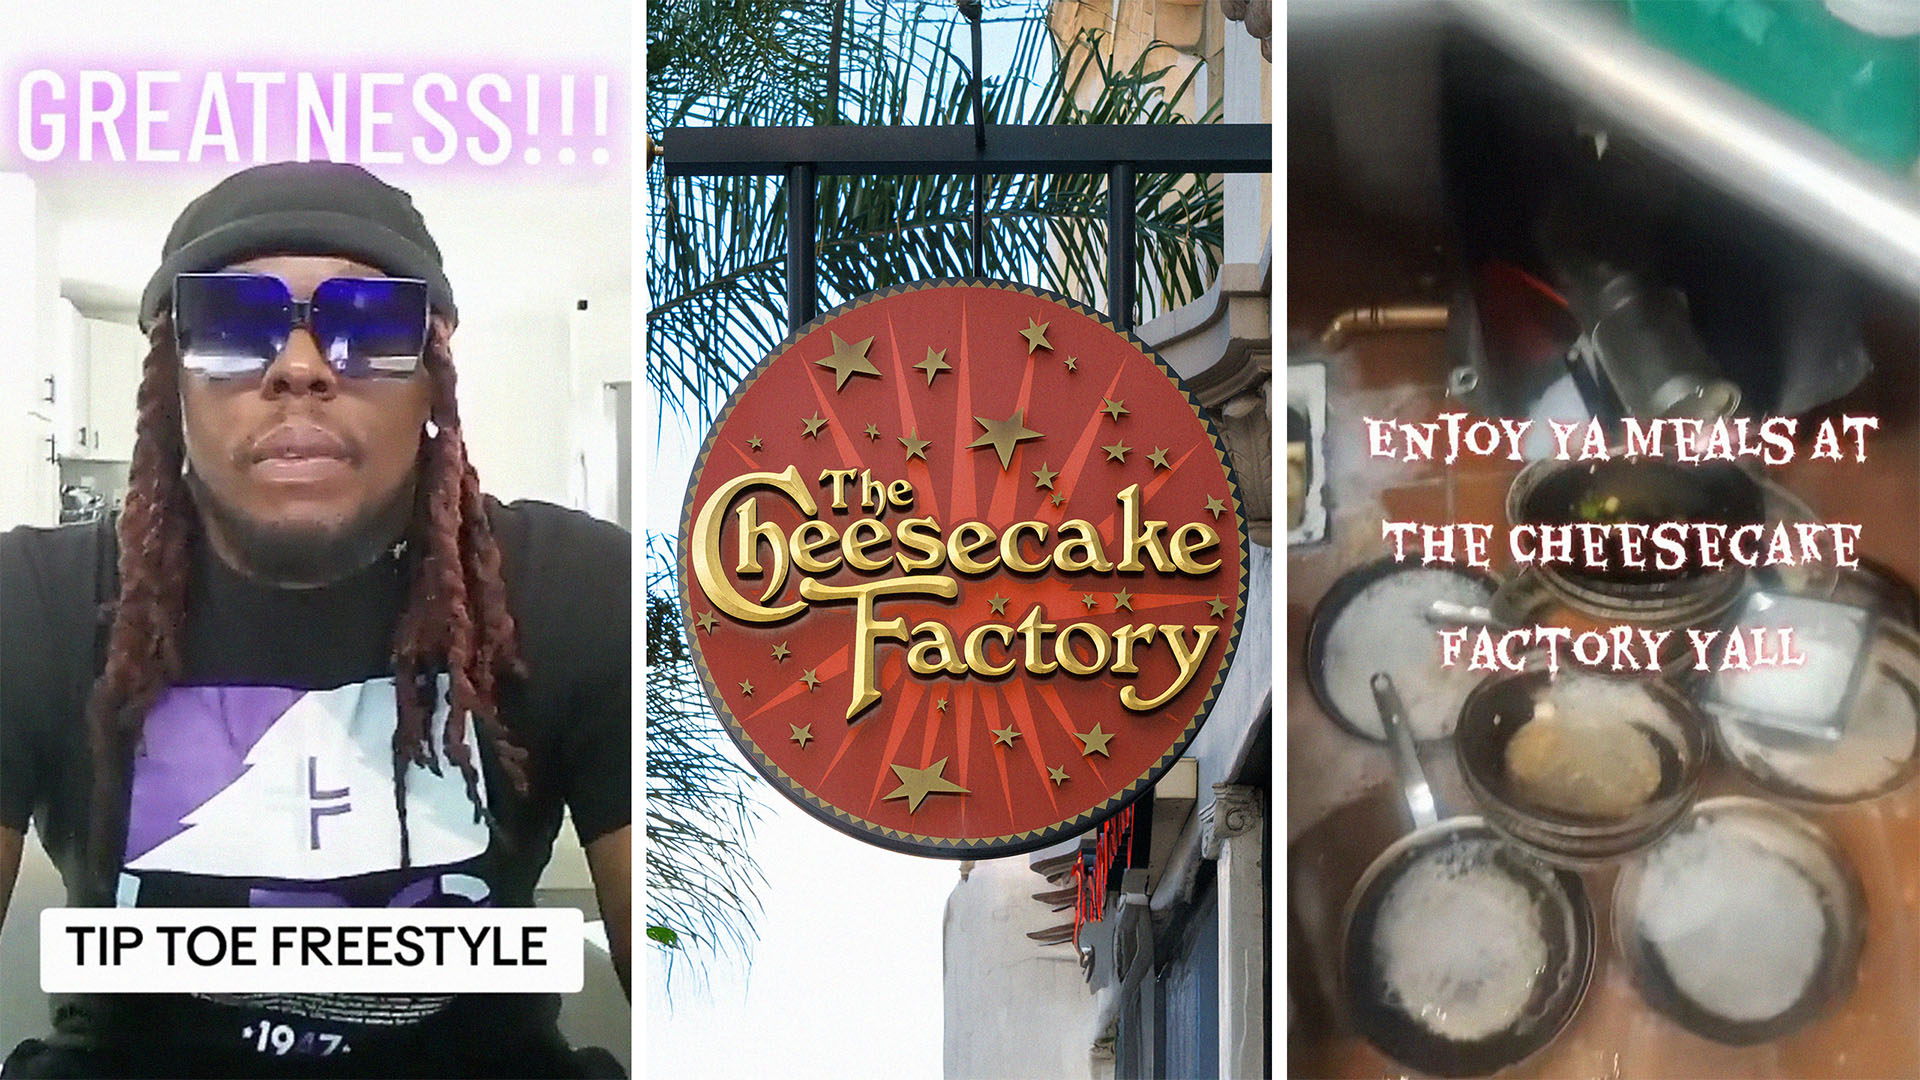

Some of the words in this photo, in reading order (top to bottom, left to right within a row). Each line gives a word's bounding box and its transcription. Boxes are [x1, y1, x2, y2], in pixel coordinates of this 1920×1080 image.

[691, 464, 1222, 623] Cheesecake
[819, 468, 914, 518] The
[800, 575, 1219, 720] Factory
